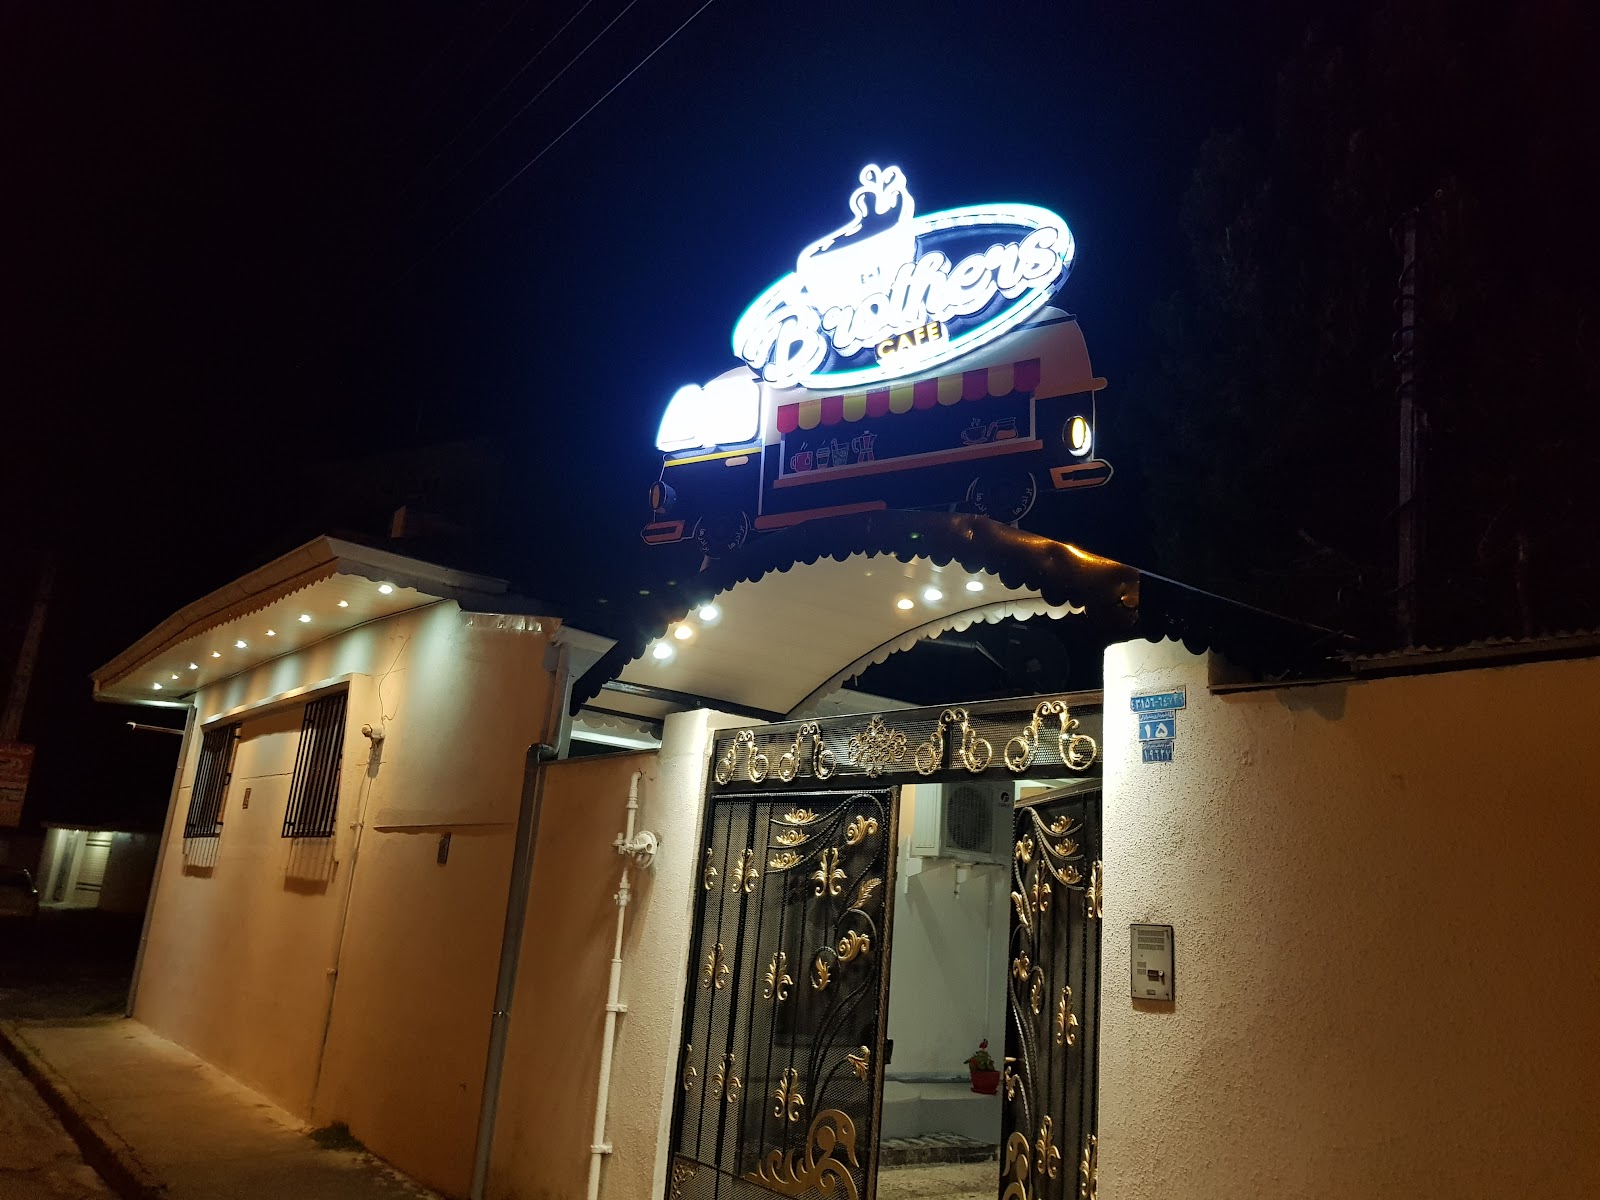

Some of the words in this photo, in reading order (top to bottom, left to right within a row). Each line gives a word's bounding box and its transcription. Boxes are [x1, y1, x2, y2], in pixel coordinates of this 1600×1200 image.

[743, 226, 1060, 384] Brothers
[877, 321, 941, 360] CAFE
[1144, 722, 1168, 739] ۱۵
